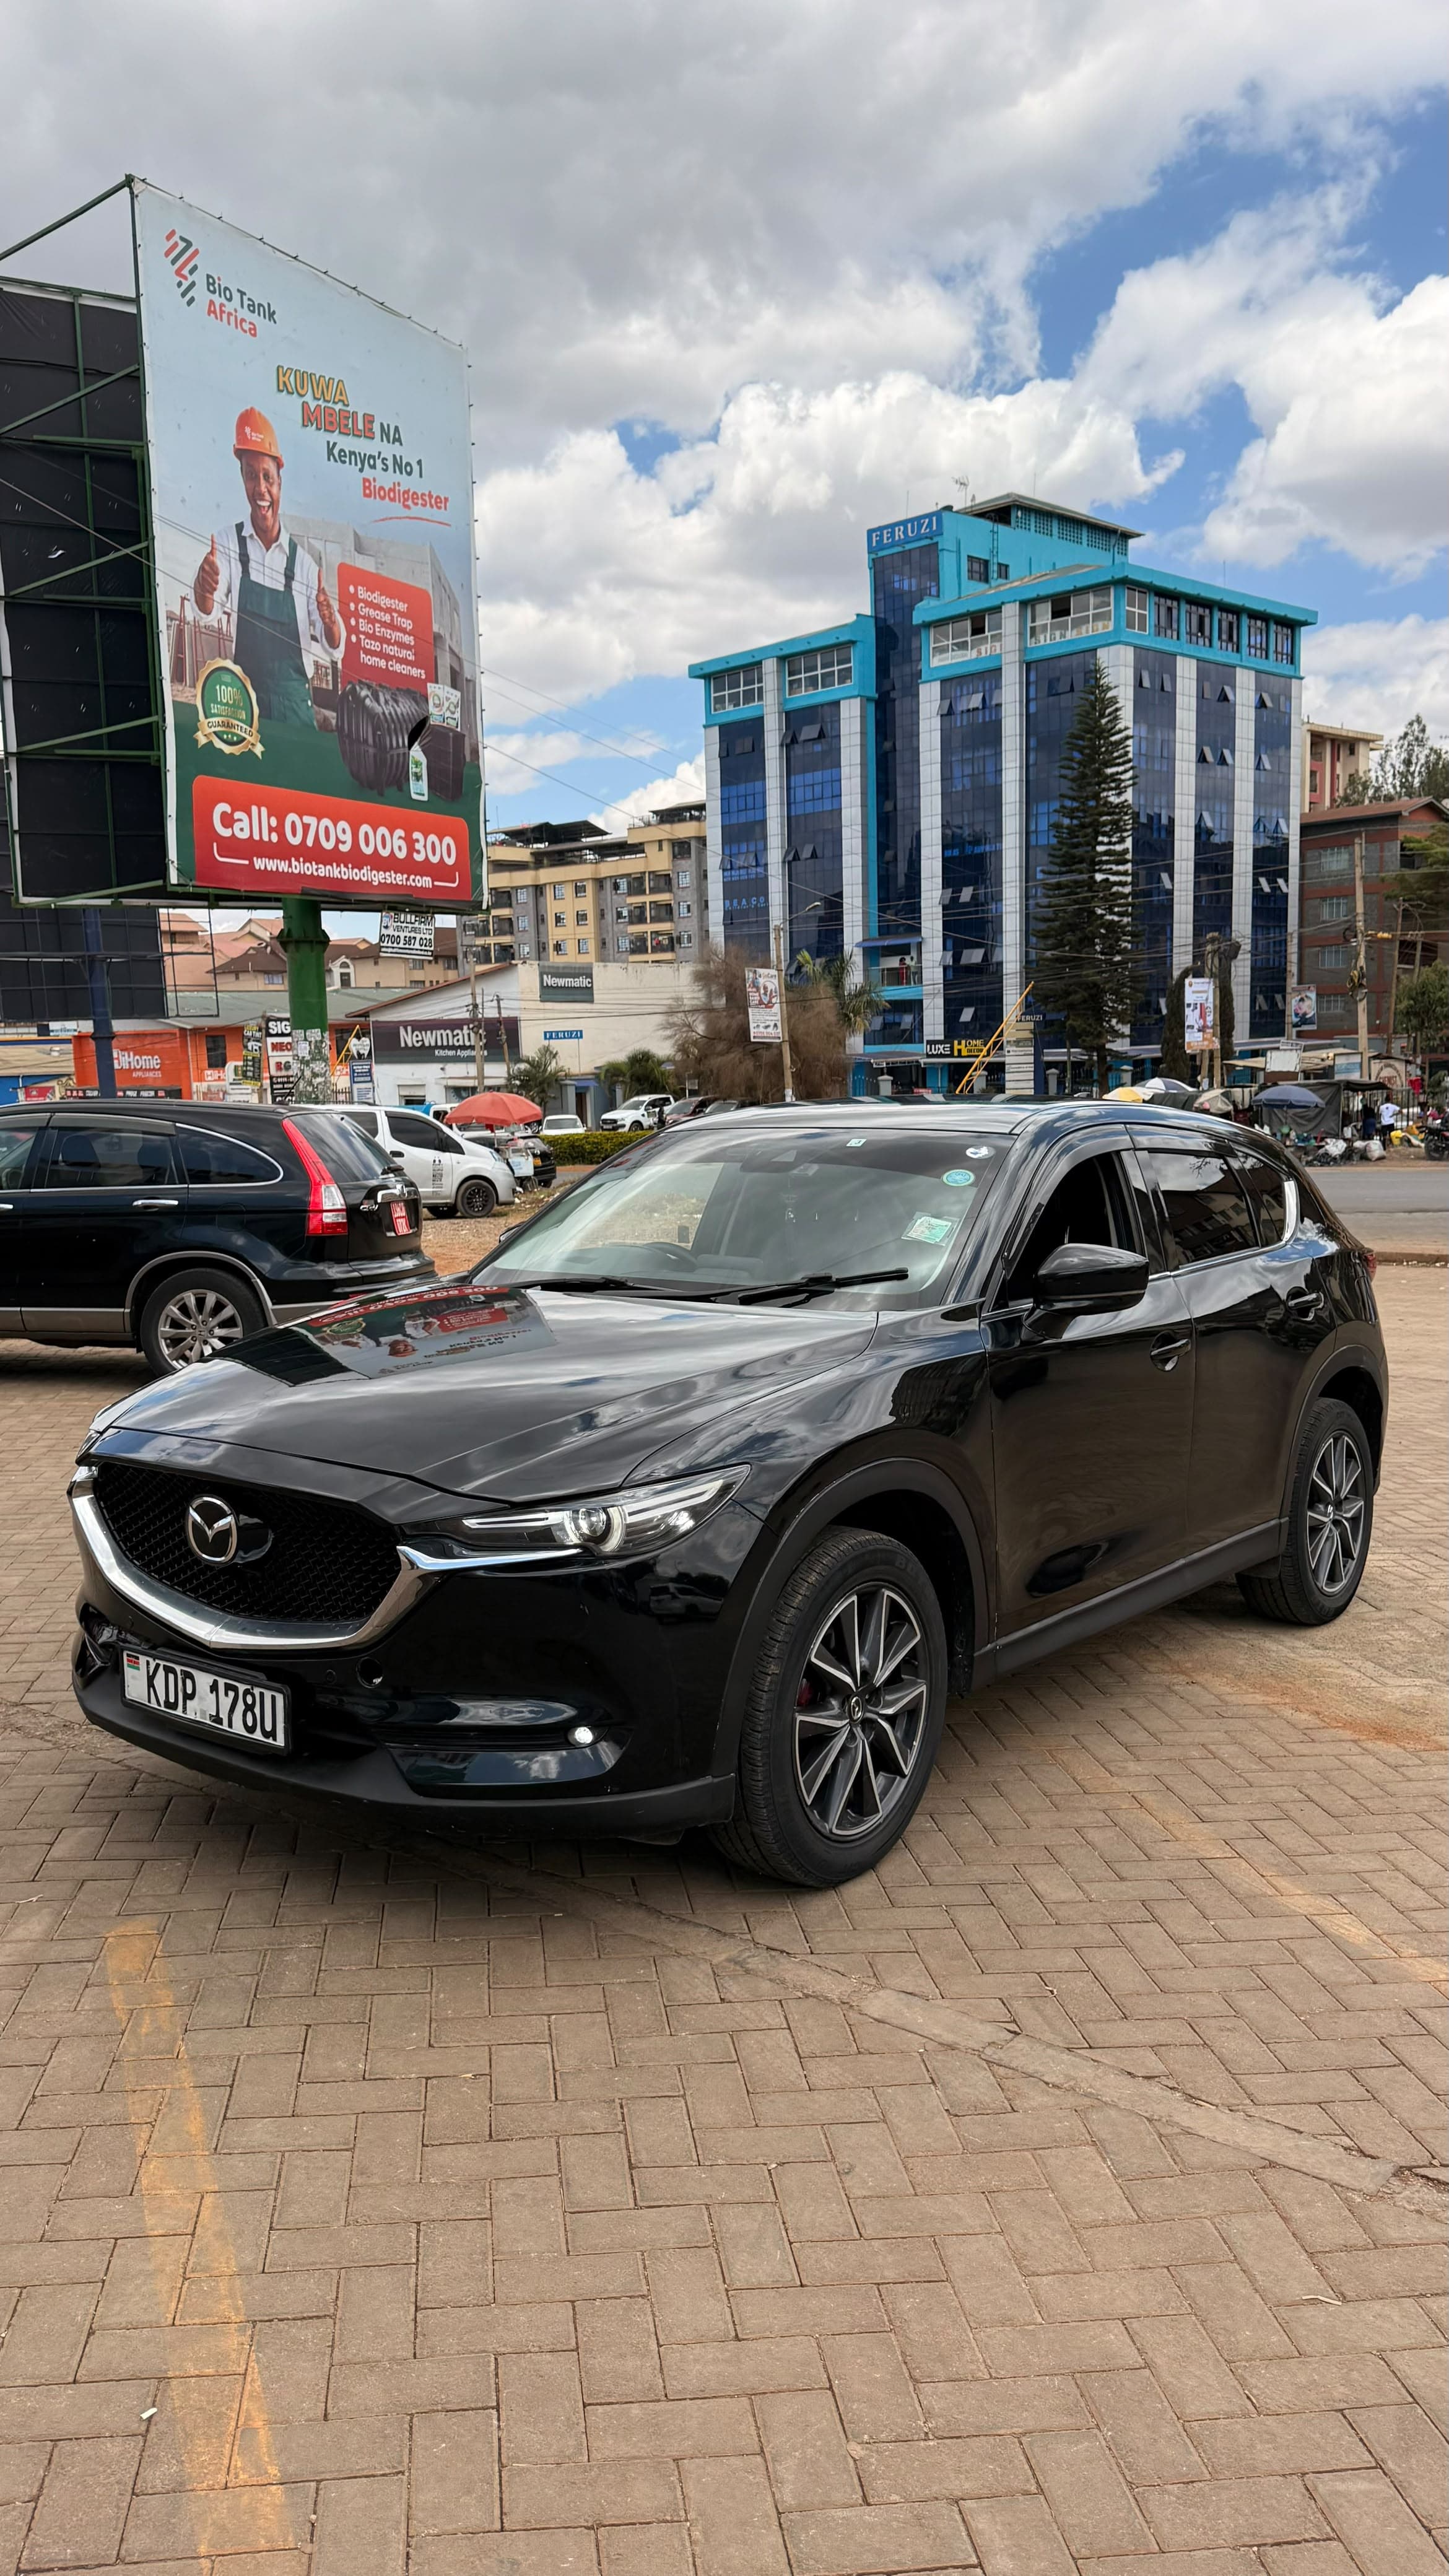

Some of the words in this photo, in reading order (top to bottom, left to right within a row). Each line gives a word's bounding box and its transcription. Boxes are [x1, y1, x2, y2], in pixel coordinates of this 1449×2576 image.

[206, 273, 233, 302] Bio
[237, 288, 277, 324] Tank
[207, 299, 257, 337] Africa
[277, 365, 349, 407] KUWA
[302, 401, 375, 440] MBELE
[380, 422, 403, 446] NA
[326, 440, 389, 473] Kenya's
[393, 454, 414, 477] No
[416, 459, 423, 478] 1
[362, 477, 449, 511] Biodigester
[871, 517, 937, 547] FERUZI
[357, 586, 408, 612] Biodigester
[358, 603, 391, 623] Grease
[392, 612, 413, 632] Trap
[359, 619, 373, 633] Bio
[375, 623, 415, 646] Enzymes
[359, 634, 381, 651] Tazo
[383, 643, 415, 661] natural
[360, 650, 386, 669] home
[388, 659, 426, 679] cleaners
[216, 684, 243, 707] 100%
[207, 720, 253, 738] GUARANTEED
[212, 802, 279, 843] Call:
[284, 812, 352, 852] 0709
[359, 824, 407, 859] 006
[412, 831, 457, 866] 300
[253, 856, 433, 889] www.biotankbiodigester.com
[393, 913, 433, 927] BULLFIRM
[393, 925, 421, 934] VENTURES
[422, 928, 433, 936] LTD
[380, 933, 401, 946] 0700
[402, 936, 417, 946] 587
[419, 937, 432, 948] 028
[543, 974, 592, 988] Newmatic
[927, 1044, 951, 1055] LUXE
[146, 1660, 196, 1715] KDP
[209, 1679, 277, 1742] 178U
